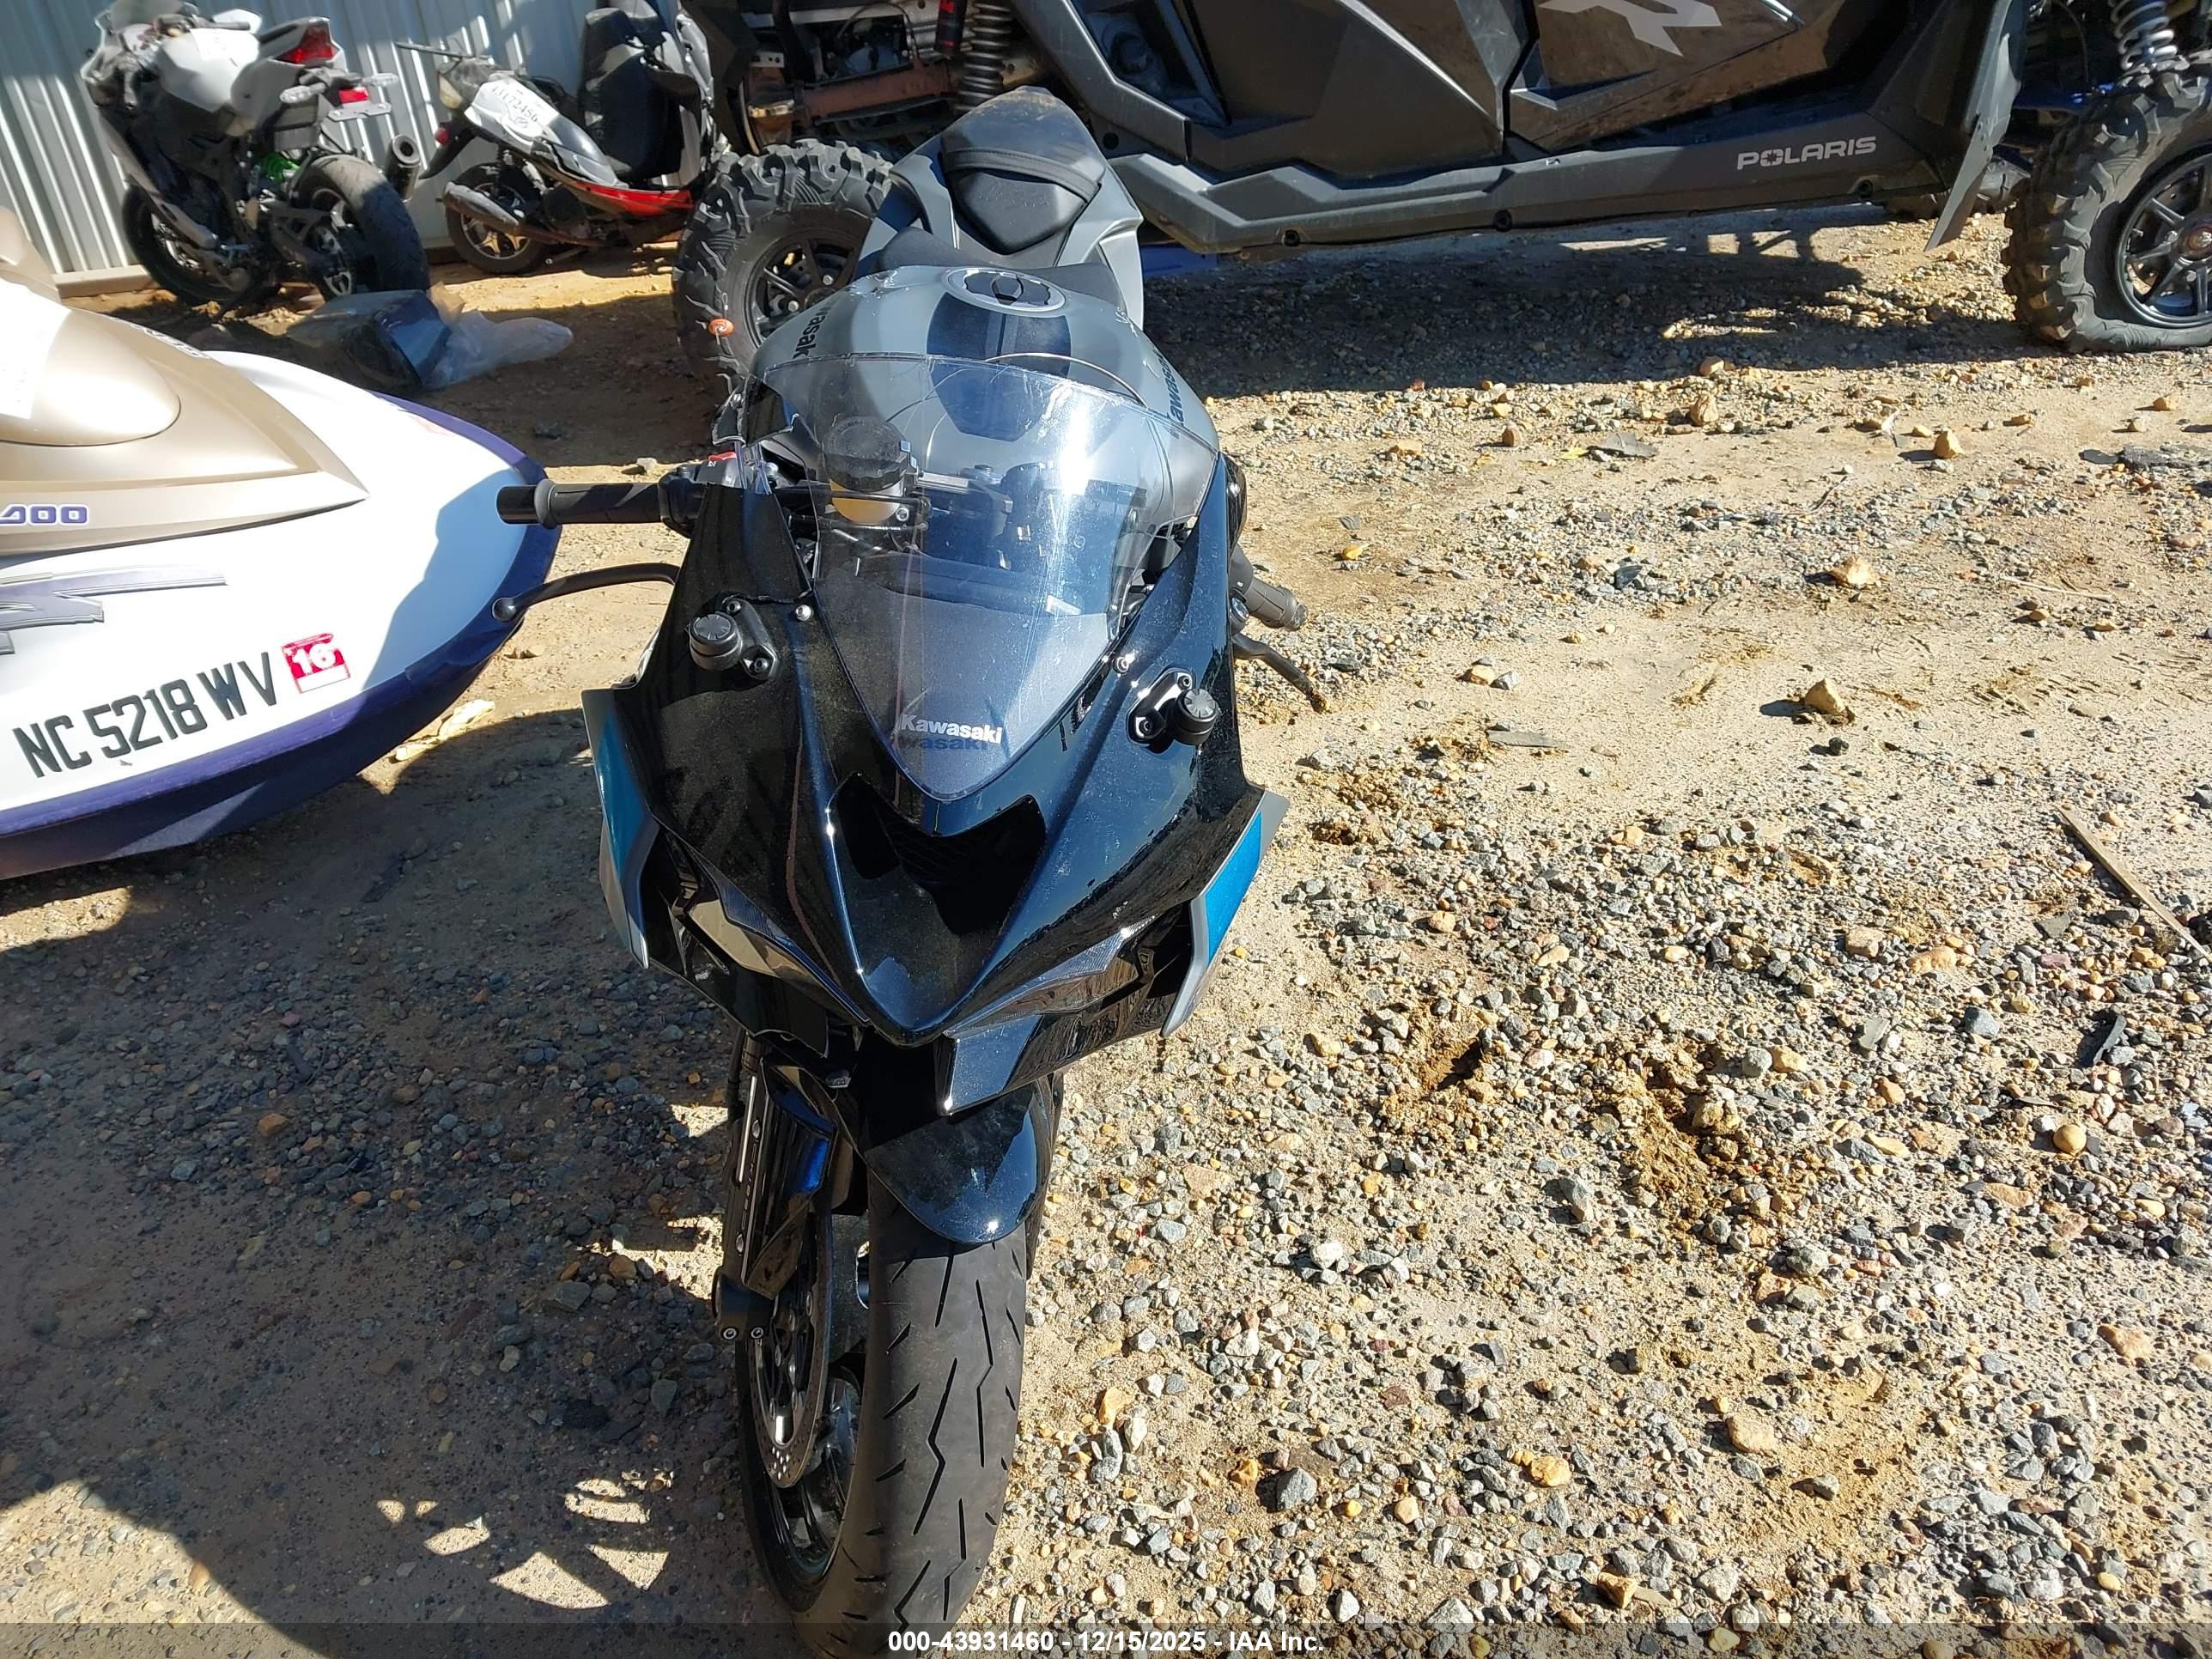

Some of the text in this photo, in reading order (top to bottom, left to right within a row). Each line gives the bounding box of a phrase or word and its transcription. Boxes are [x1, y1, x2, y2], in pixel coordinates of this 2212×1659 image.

[1737, 136, 1876, 170] POLARIS
[13, 652, 276, 778] NC 5218 WV
[901, 714, 1003, 744] Kawasaki
